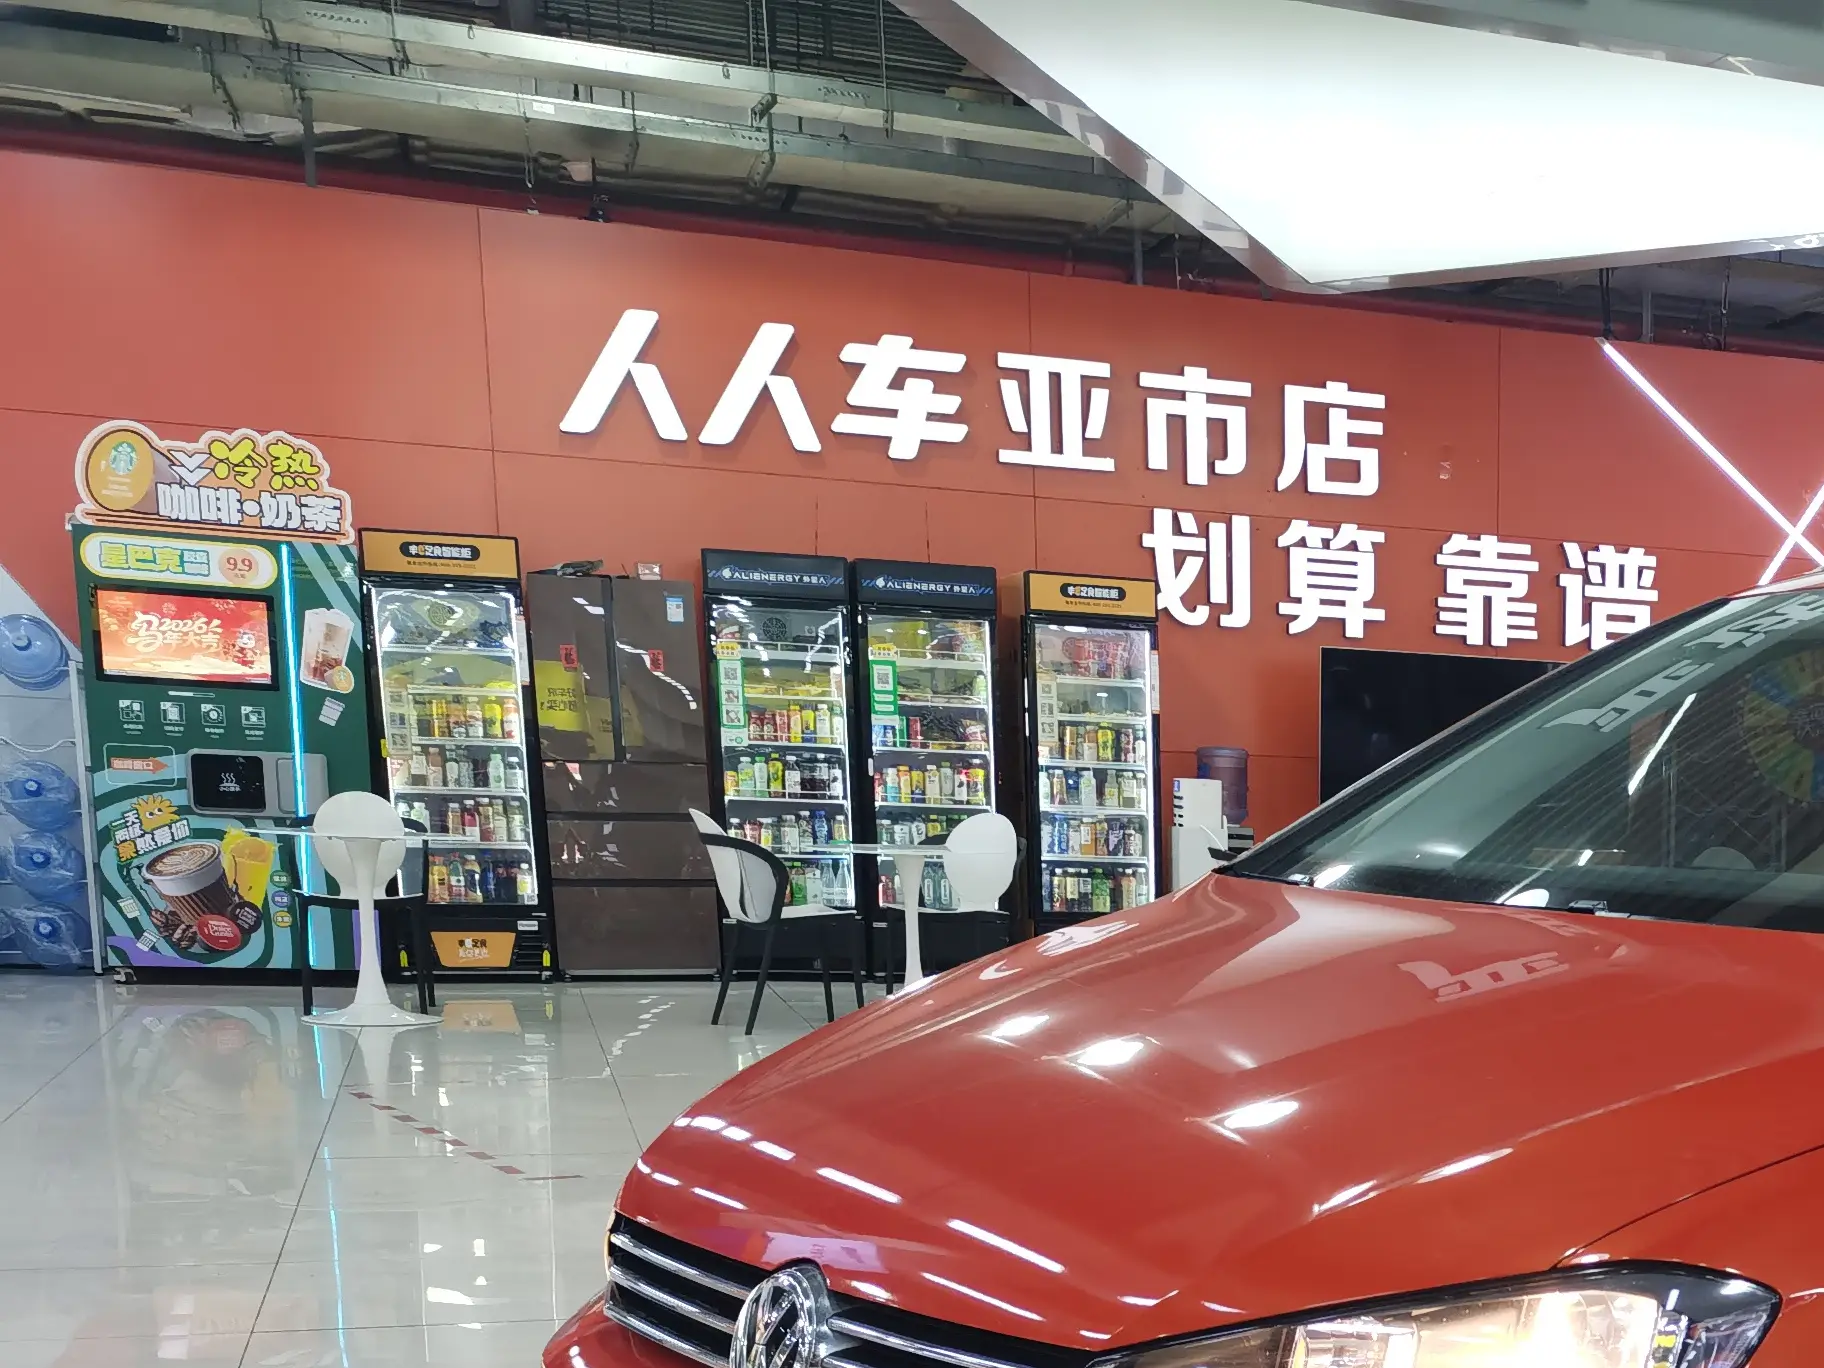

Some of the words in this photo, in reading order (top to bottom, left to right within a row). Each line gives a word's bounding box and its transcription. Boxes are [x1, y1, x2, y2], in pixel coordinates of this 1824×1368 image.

[208, 437, 320, 490] 冷热
[101, 543, 183, 574] 星巴克
[226, 556, 253, 573] 9.9
[733, 571, 801, 582] ALIENERGY
[1140, 506, 1386, 638] 划算
[1435, 532, 1659, 650] 靠谱
[886, 580, 951, 592] ALIENERGY
[160, 617, 208, 634] 2026
